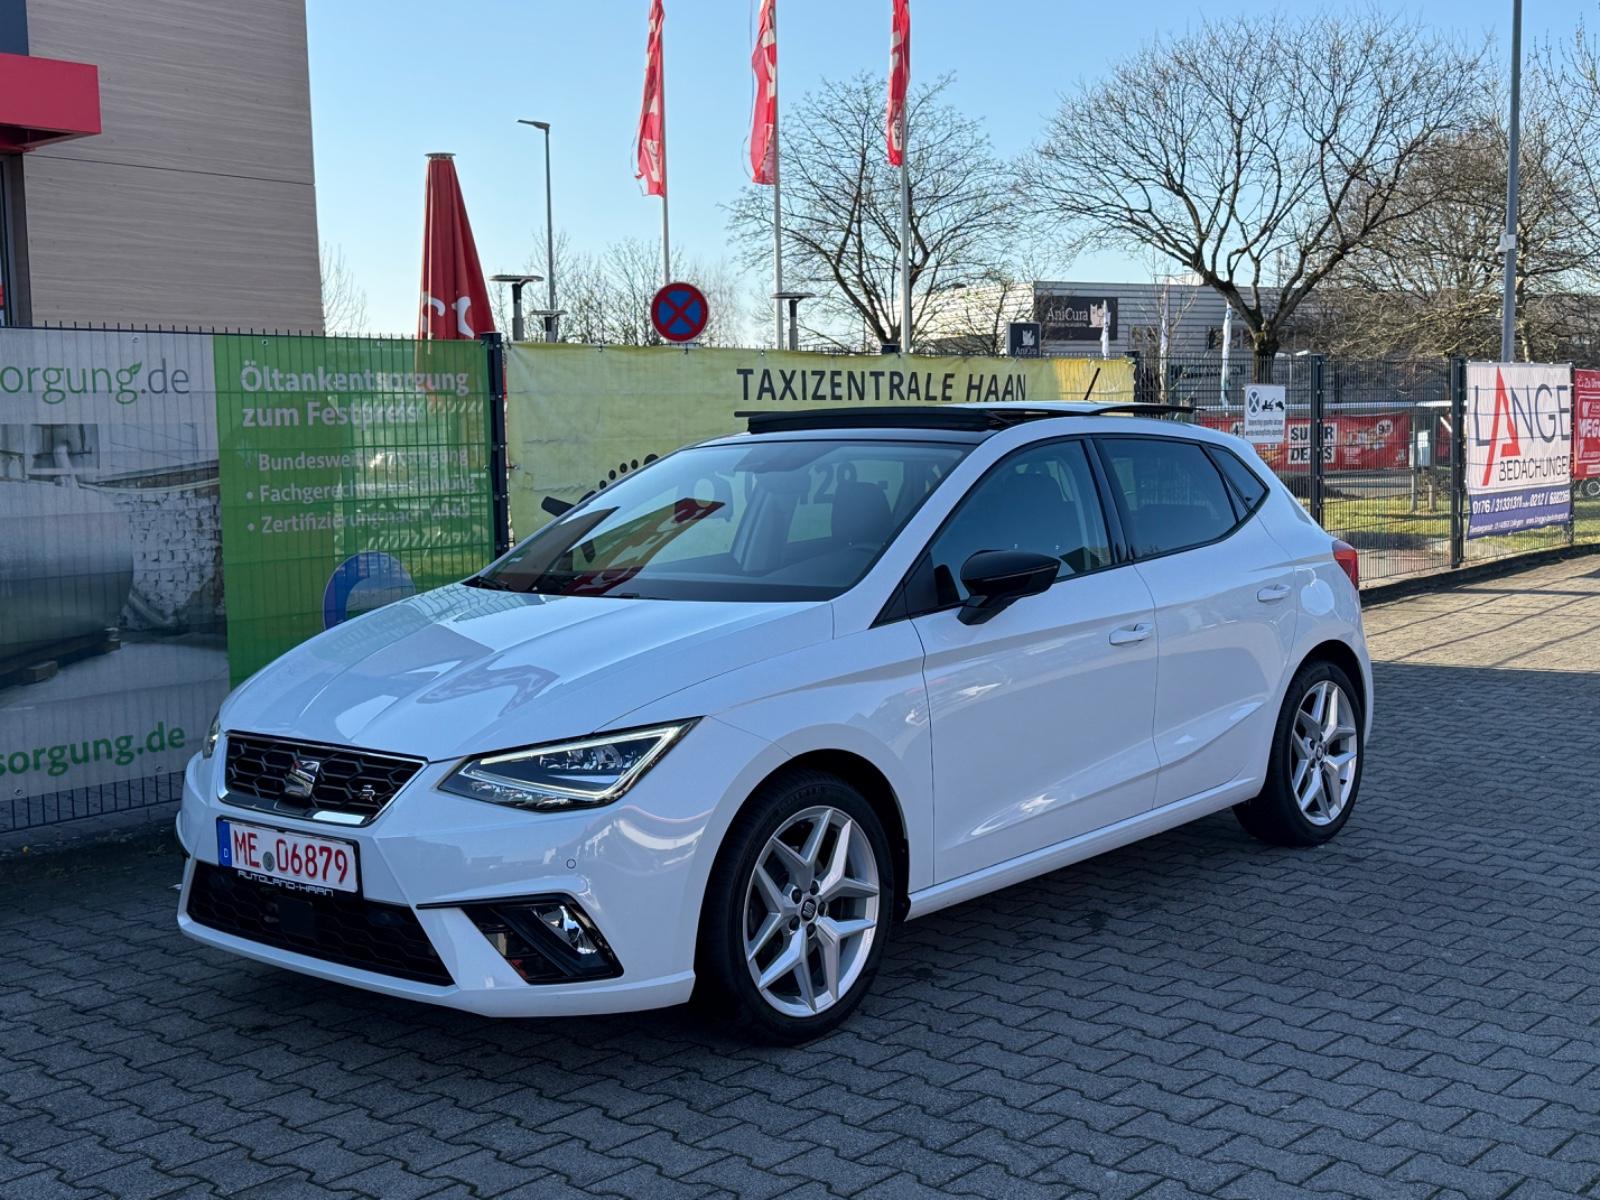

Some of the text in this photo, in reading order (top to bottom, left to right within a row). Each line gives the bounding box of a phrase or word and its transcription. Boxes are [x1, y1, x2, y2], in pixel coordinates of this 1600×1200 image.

[1046, 306, 1089, 321] AniCura
[0, 358, 190, 405] orgung.de
[240, 359, 469, 396] Öltankentsorgung
[736, 368, 1027, 402] TAXIZENTRALE HAAN
[242, 401, 418, 431] zum Festpreis
[1474, 366, 1570, 486] LANGE
[1290, 426, 1333, 440] SUR
[1291, 446, 1333, 461] DES
[1499, 456, 1569, 481] BEDACHUNGE
[261, 511, 380, 533] Zertifizierung
[233, 829, 348, 885] ME 06879
